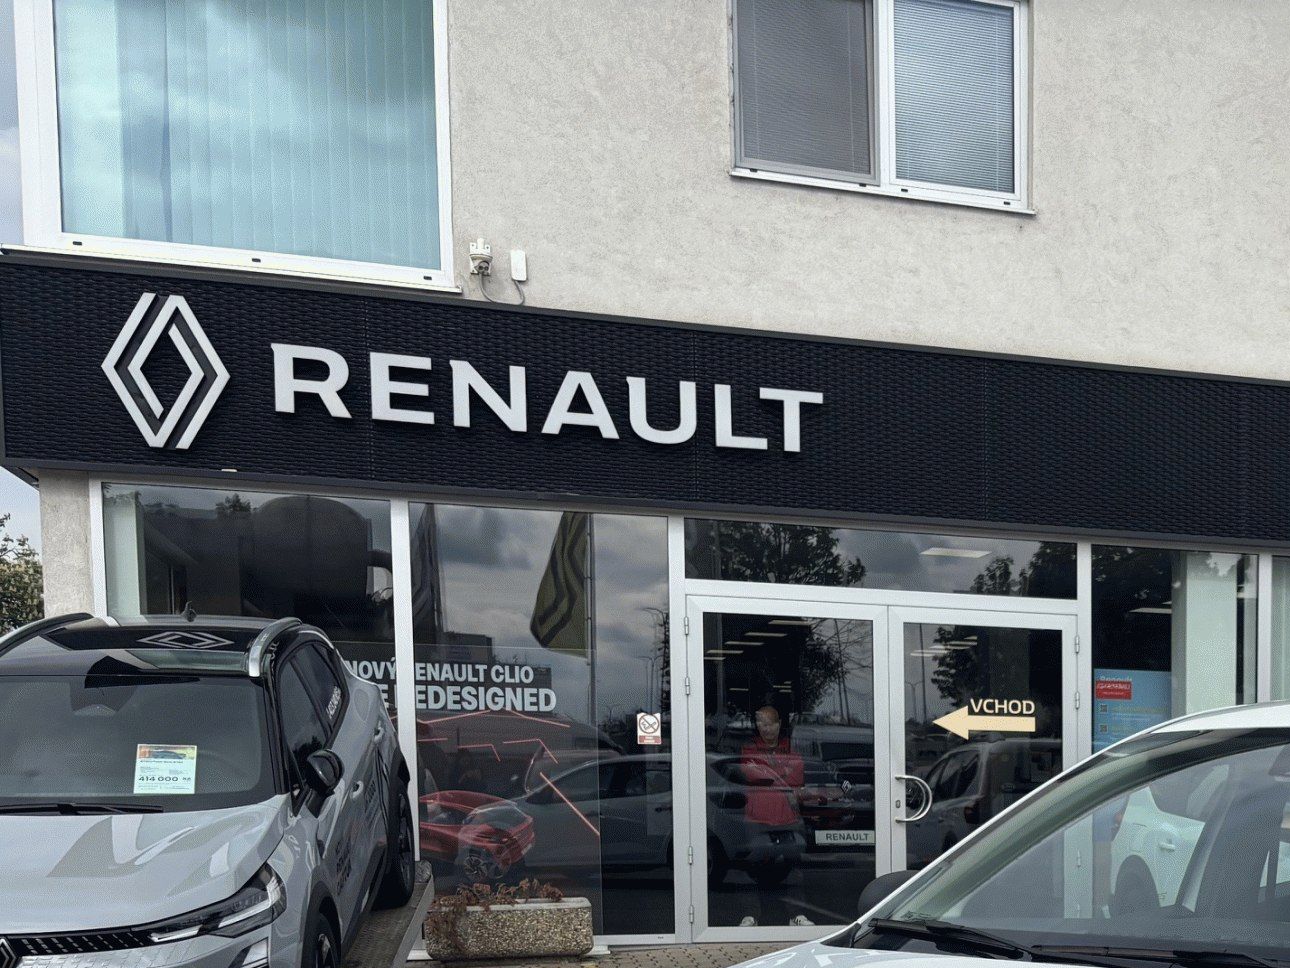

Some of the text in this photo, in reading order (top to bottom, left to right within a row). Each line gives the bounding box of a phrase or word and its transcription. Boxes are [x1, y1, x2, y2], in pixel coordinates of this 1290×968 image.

[270, 343, 824, 453] RENAULT
[415, 662, 488, 683] ENAULT
[490, 664, 535, 684] CLIO
[395, 685, 557, 711] EDESIGNED
[970, 698, 1036, 715] VCHOD
[825, 832, 870, 842] RENAULT
